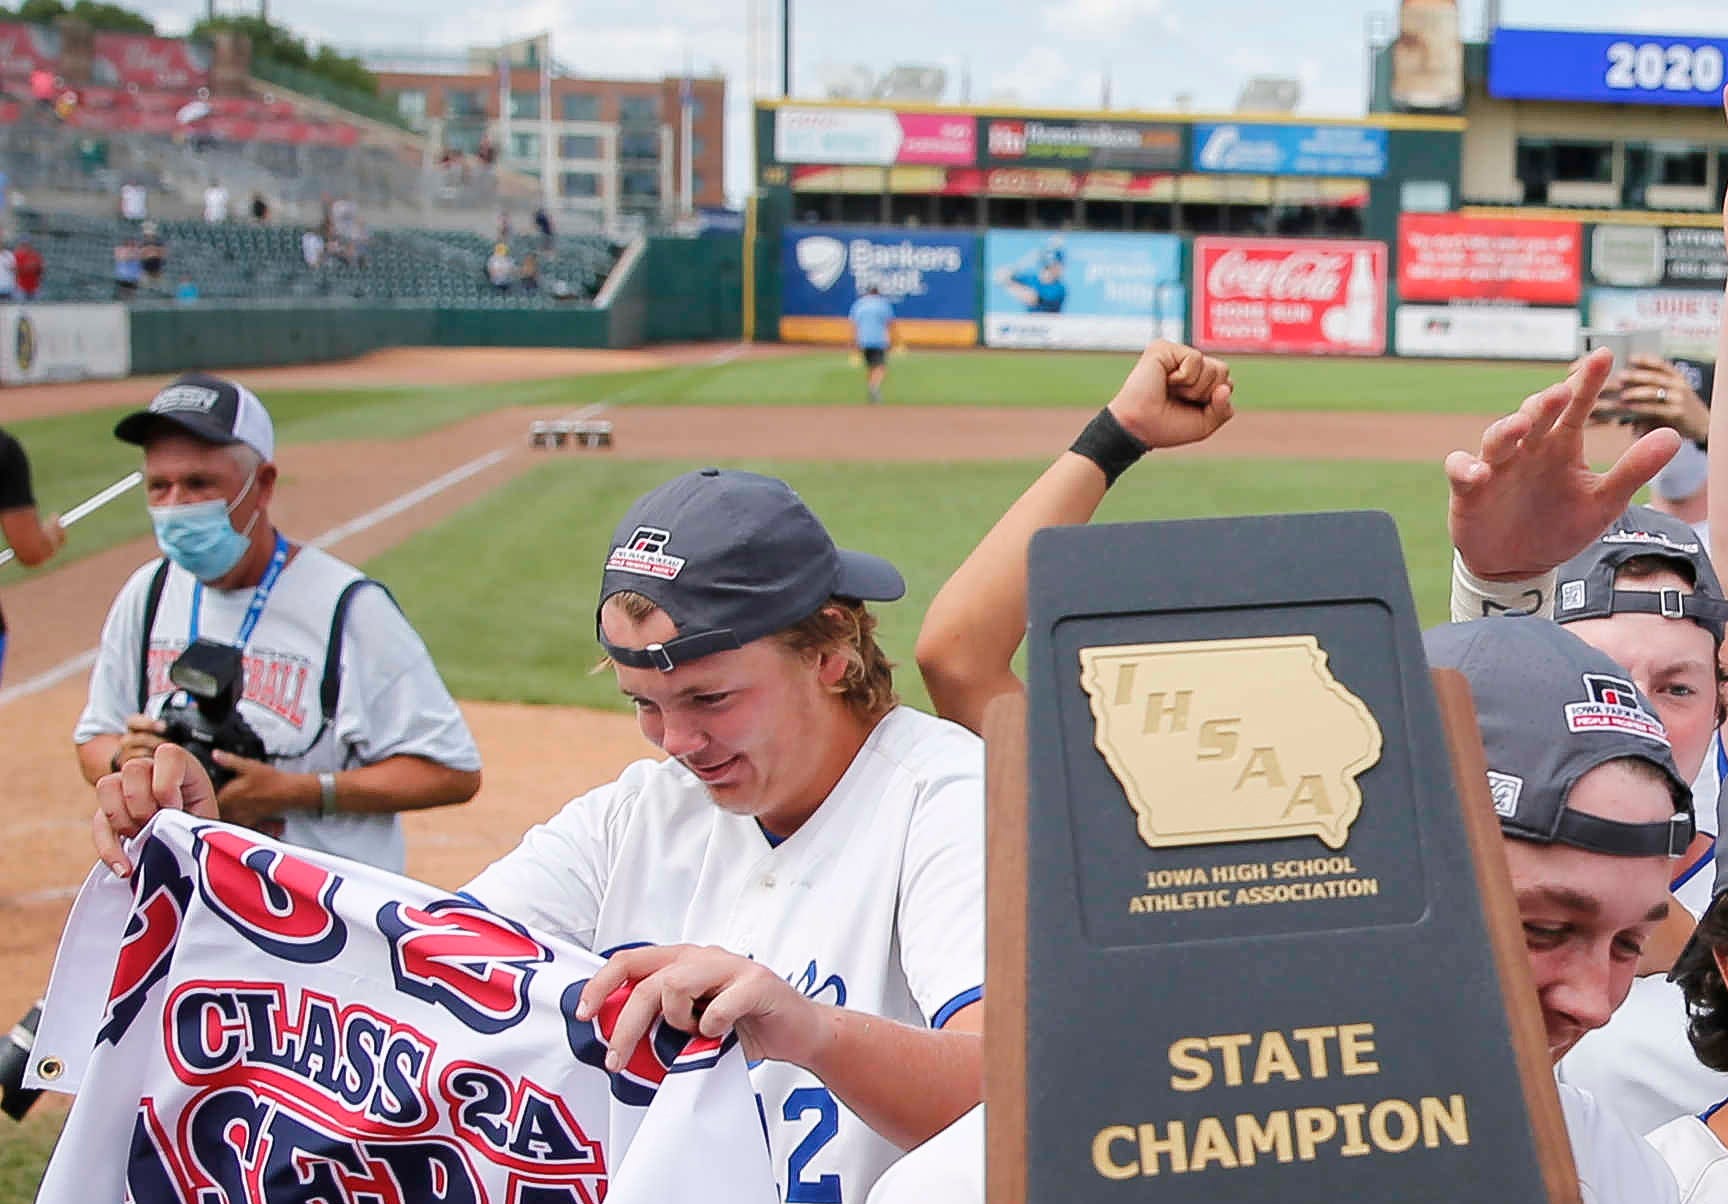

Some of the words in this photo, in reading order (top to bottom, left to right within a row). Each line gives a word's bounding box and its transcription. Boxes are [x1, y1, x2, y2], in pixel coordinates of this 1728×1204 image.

[1606, 42, 1724, 92] 2020
[850, 239, 961, 272] Bankers
[1207, 249, 1347, 300] Coca-Cola
[1128, 889, 1231, 914] ATHLETIC
[1235, 878, 1379, 905] ASSOCIATION
[1147, 868, 1208, 889] IOWA
[1212, 863, 1268, 883] HIGH
[1272, 857, 1357, 879] SCHOOL
[168, 982, 438, 1134] CLASS
[443, 1062, 605, 1172] 2A
[1167, 1023, 1380, 1092] STATE
[754, 1087, 843, 1204] 2
[1091, 1093, 1470, 1180] CHAMPION
